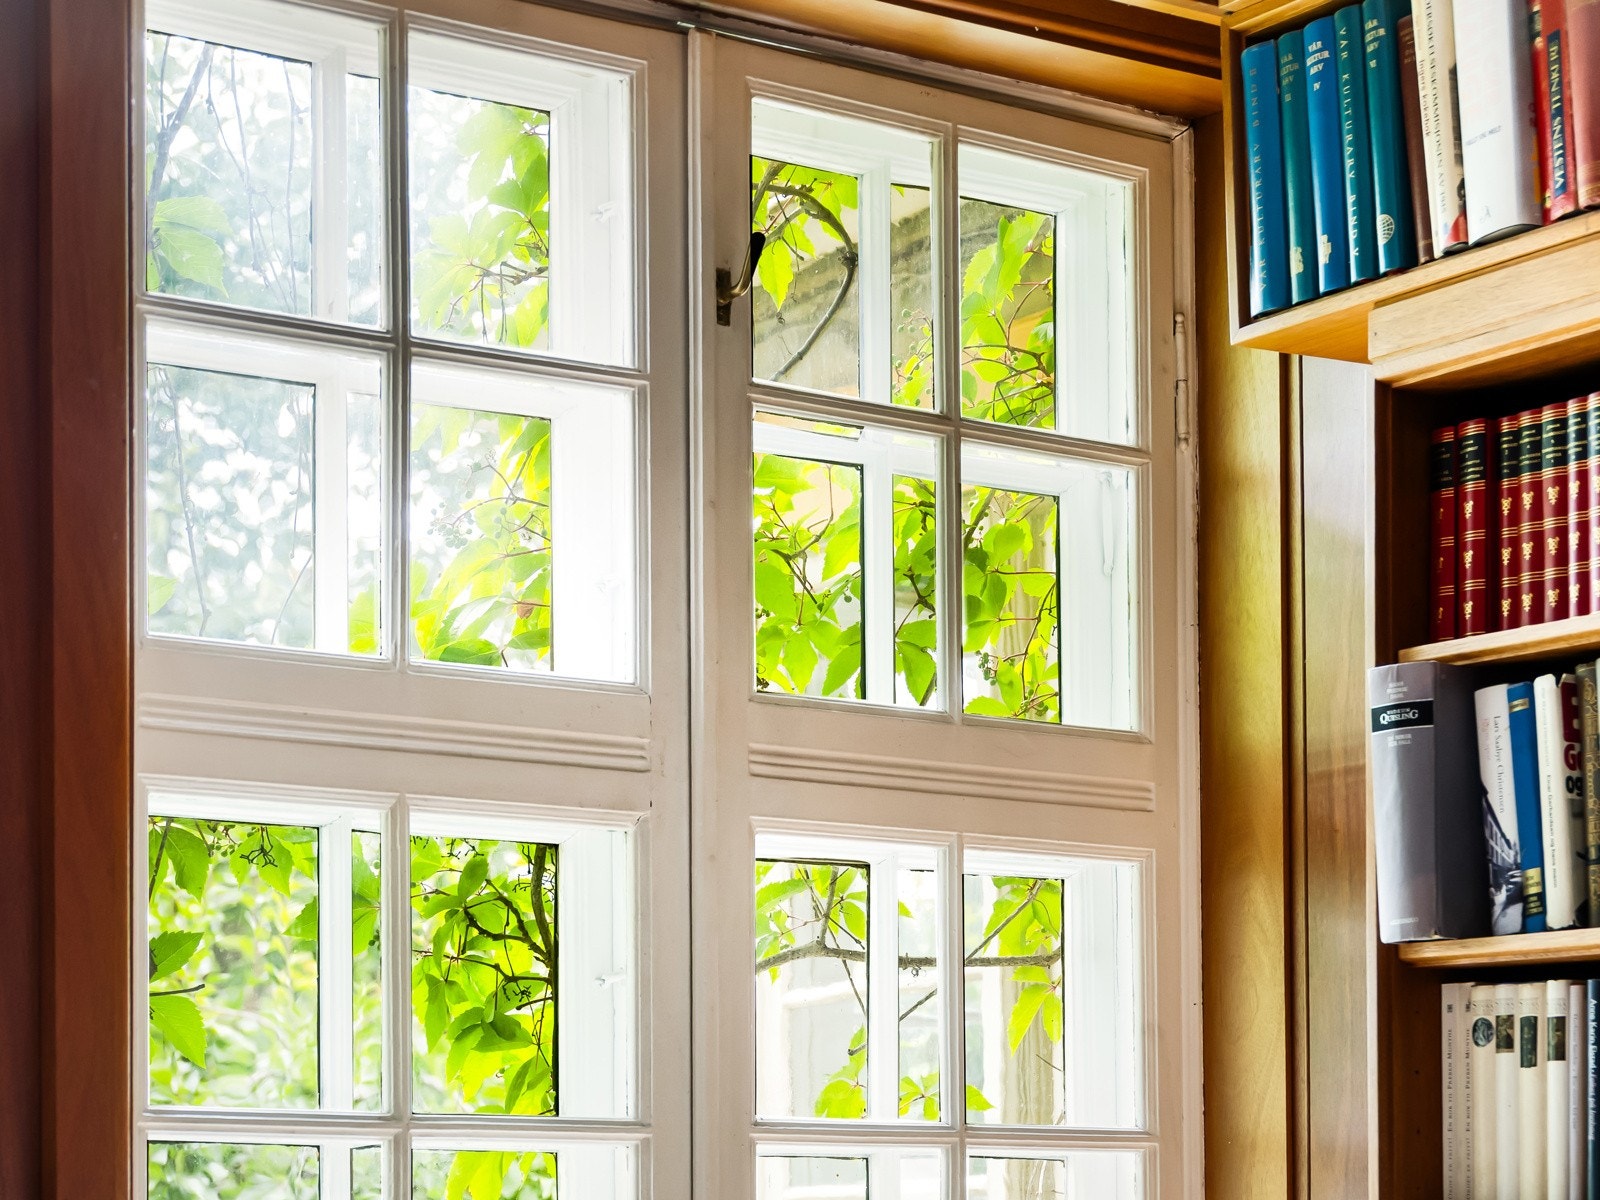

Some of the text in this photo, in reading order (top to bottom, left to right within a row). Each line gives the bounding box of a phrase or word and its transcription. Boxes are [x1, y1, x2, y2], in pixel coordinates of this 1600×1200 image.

[1251, 83, 1260, 127] BIND
[1342, 73, 1356, 179] KULTURARV
[1350, 194, 1358, 241] BIND
[1552, 117, 1566, 190] VESTENS
[1252, 143, 1265, 245] KULTURARV
[1379, 709, 1418, 725] QUISLING
[1493, 715, 1502, 732] Lars
[1496, 764, 1506, 814] Christensen
[1588, 998, 1597, 1018] Anne
[1588, 1020, 1597, 1041] Karin
